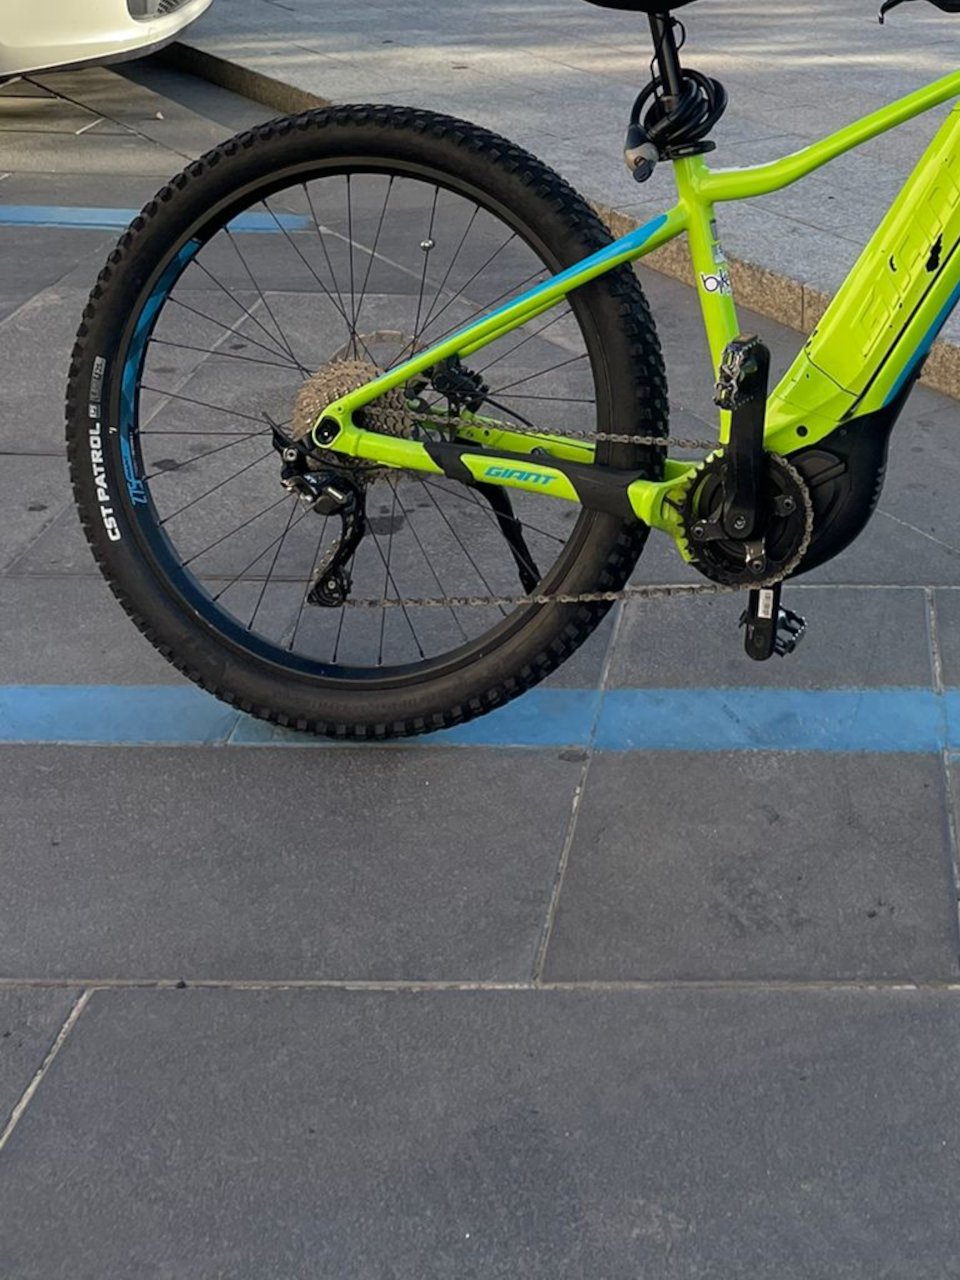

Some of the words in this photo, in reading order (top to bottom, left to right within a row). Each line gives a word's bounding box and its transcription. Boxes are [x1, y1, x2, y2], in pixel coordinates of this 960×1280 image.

[89, 422, 110, 502] PATROL
[484, 466, 558, 485] GIANT
[100, 505, 122, 541] CST
